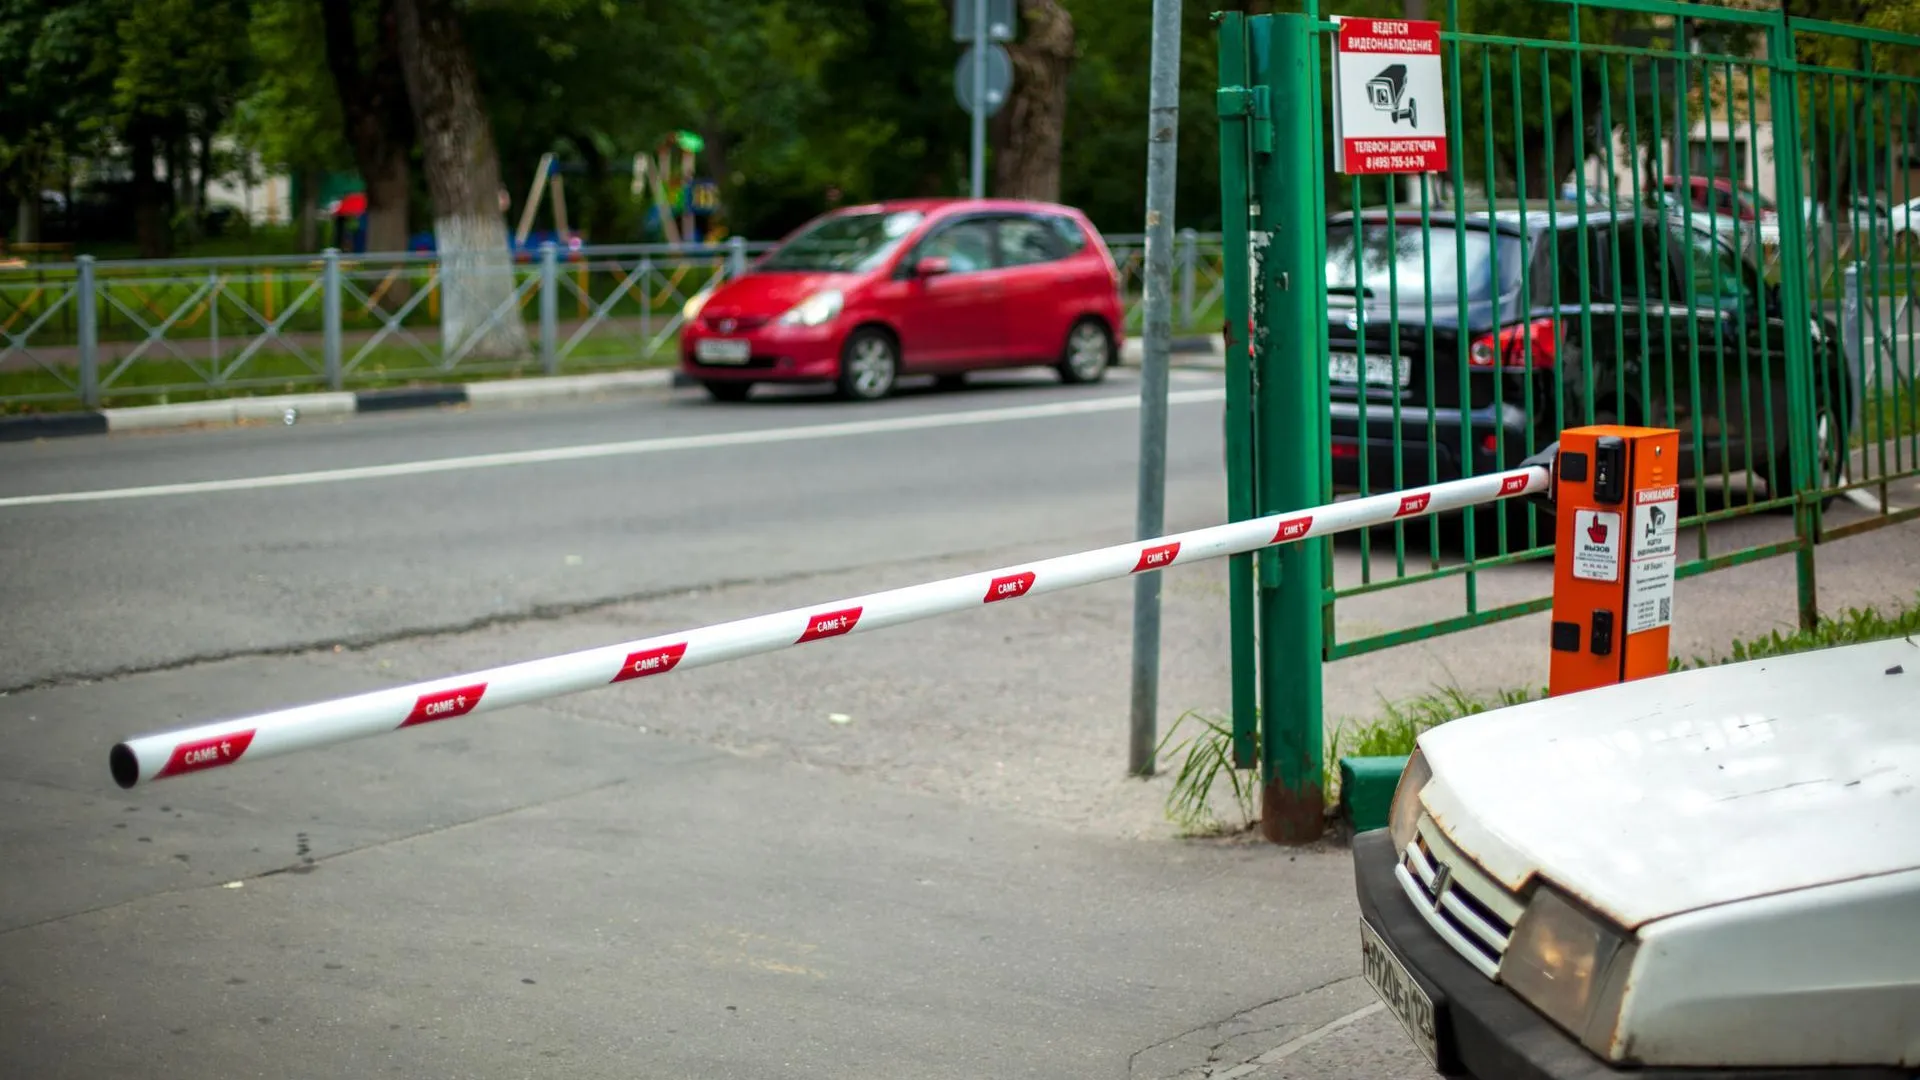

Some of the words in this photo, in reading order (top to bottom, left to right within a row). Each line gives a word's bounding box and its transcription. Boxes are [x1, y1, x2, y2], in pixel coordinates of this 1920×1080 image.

[1371, 21, 1409, 36] ВЕДЕТСЯ
[1347, 36, 1433, 52] ВИДЕОНАБЛЮДЕНИЕ
[1353, 141, 1389, 153] ТЕЛЕФОН
[1389, 140, 1437, 154] ДИСПЕТЧЕРА
[1638, 487, 1676, 503] ВНИМАНИЕ
[1583, 544, 1611, 553] ВЫЗОВ
[1147, 552, 1164, 564] CAME
[997, 581, 1017, 594] CAME
[817, 619, 839, 633] CAME
[634, 657, 660, 672] CAME
[425, 698, 455, 716] CAME
[184, 746, 219, 765] CAME
